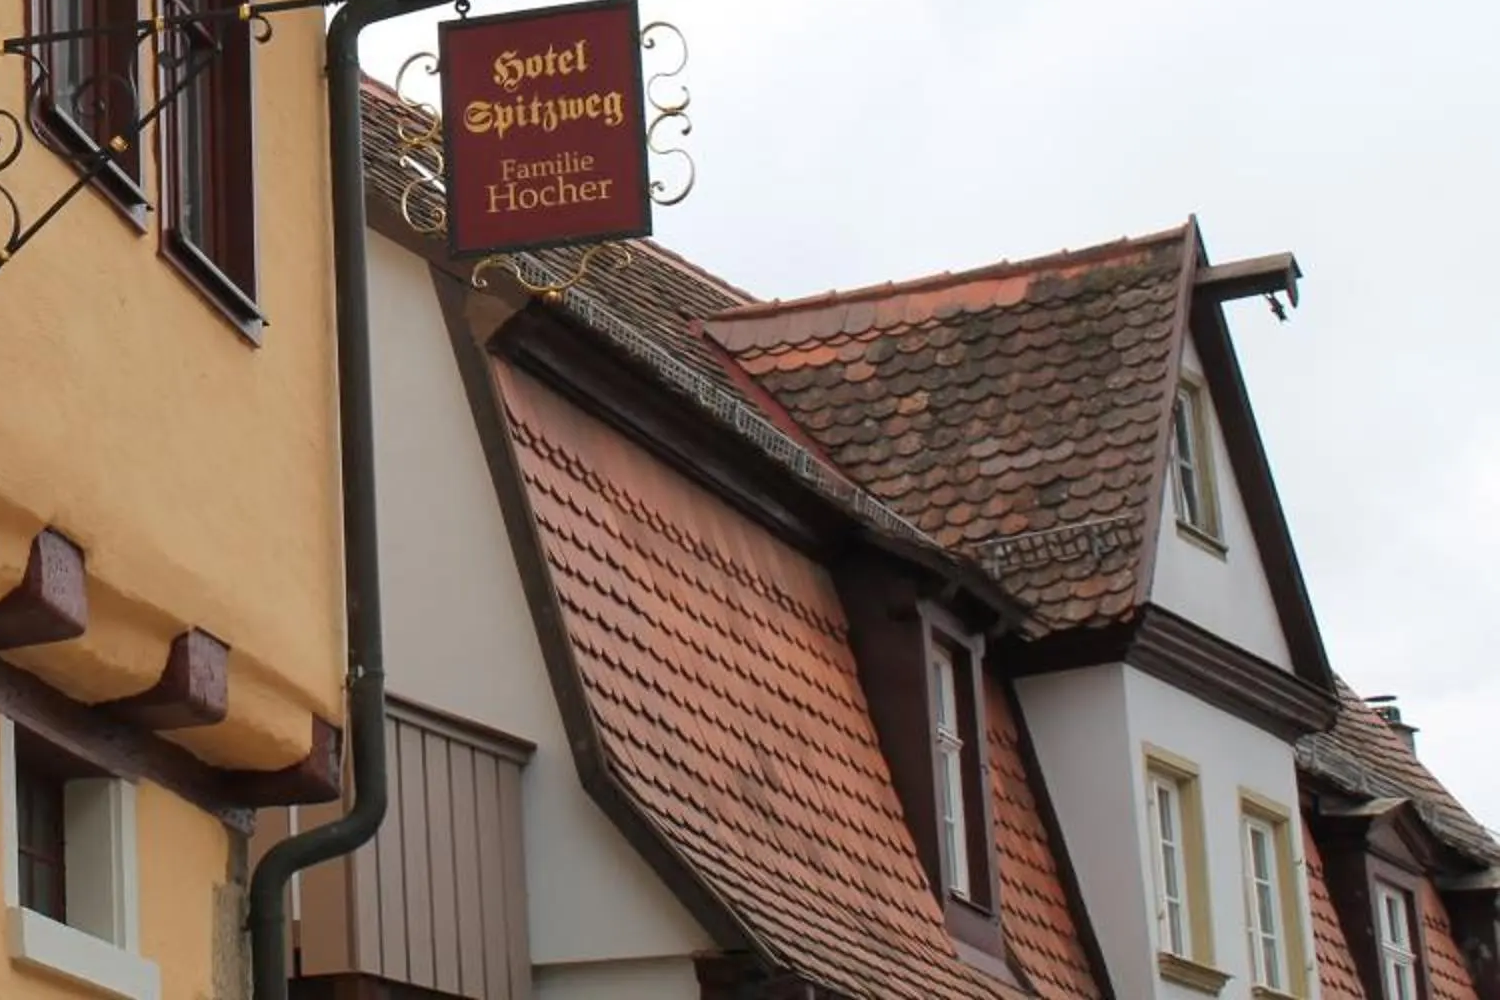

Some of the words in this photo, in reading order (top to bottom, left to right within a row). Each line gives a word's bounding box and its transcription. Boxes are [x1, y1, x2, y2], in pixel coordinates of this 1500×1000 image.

[493, 40, 589, 92] Hotel
[463, 91, 625, 139] Spitzweg
[501, 151, 595, 181] Familie
[485, 176, 613, 213] Hocher
